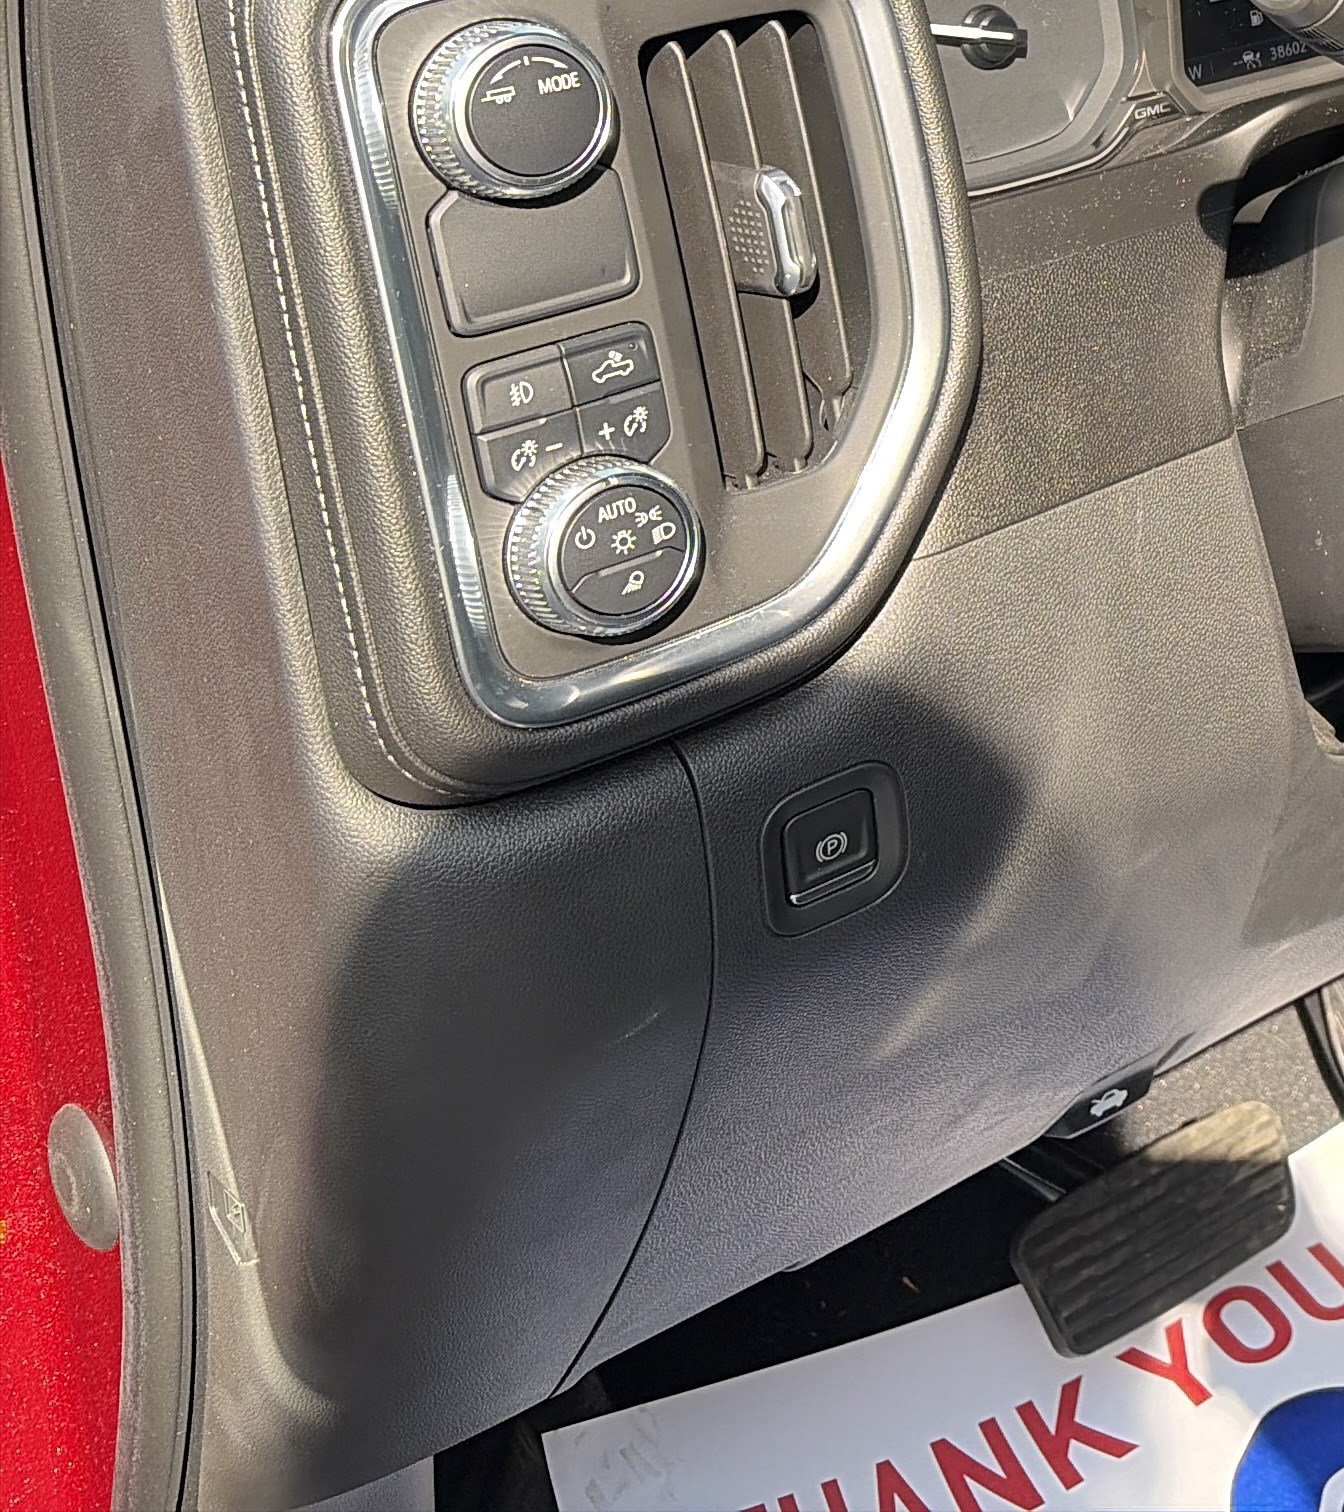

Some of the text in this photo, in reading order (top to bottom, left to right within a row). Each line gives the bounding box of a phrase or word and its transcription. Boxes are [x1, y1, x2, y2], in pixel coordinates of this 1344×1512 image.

[1269, 41, 1308, 62] 38602
[537, 71, 581, 95] MODE
[1188, 64, 1202, 81] W
[1134, 101, 1172, 120] GMC
[598, 496, 637, 524] AUTO
[738, 1375, 1140, 1512] ANK
